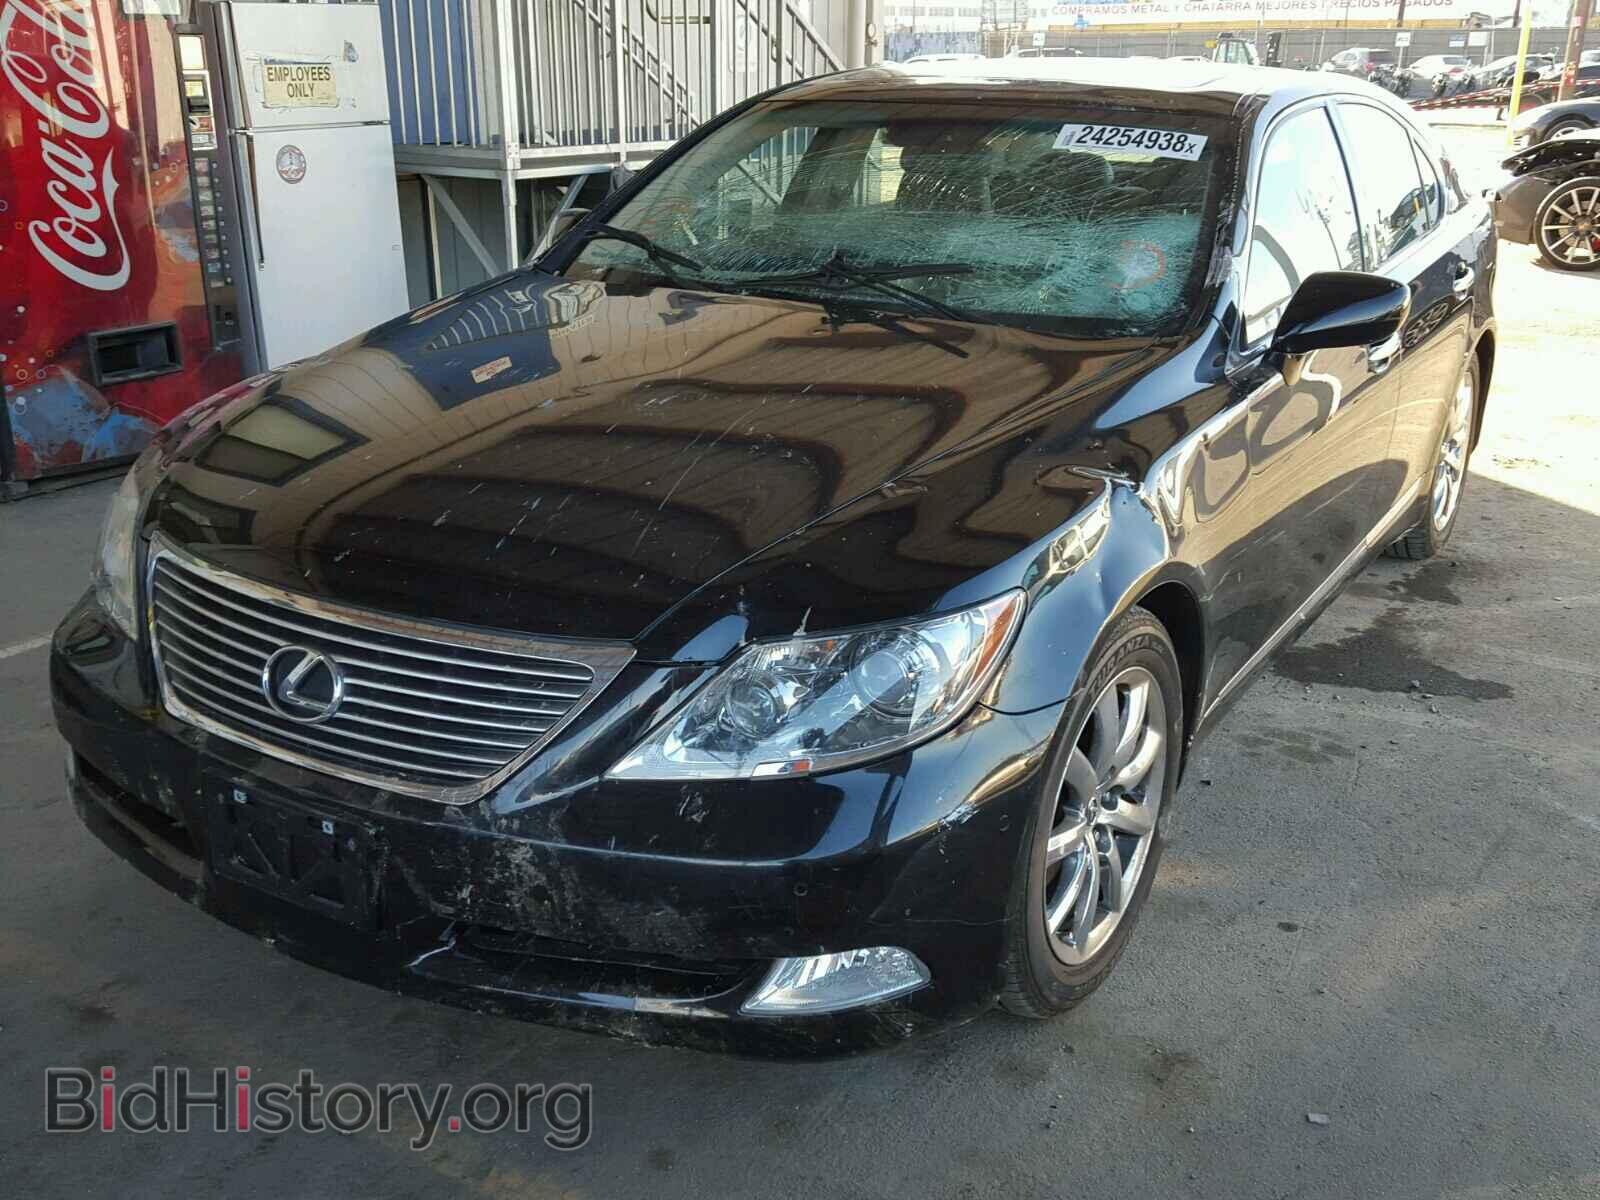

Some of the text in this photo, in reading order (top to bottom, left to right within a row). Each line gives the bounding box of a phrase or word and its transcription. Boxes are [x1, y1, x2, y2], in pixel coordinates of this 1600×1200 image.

[1051, 5, 1127, 15] COMPRAMOS
[1130, 4, 1168, 14] METAL
[1184, 2, 1251, 12] CHATARRA
[1256, 1, 1317, 11] MEJORES
[266, 67, 332, 82] EMPLOYEES
[286, 83, 315, 98] ONLY
